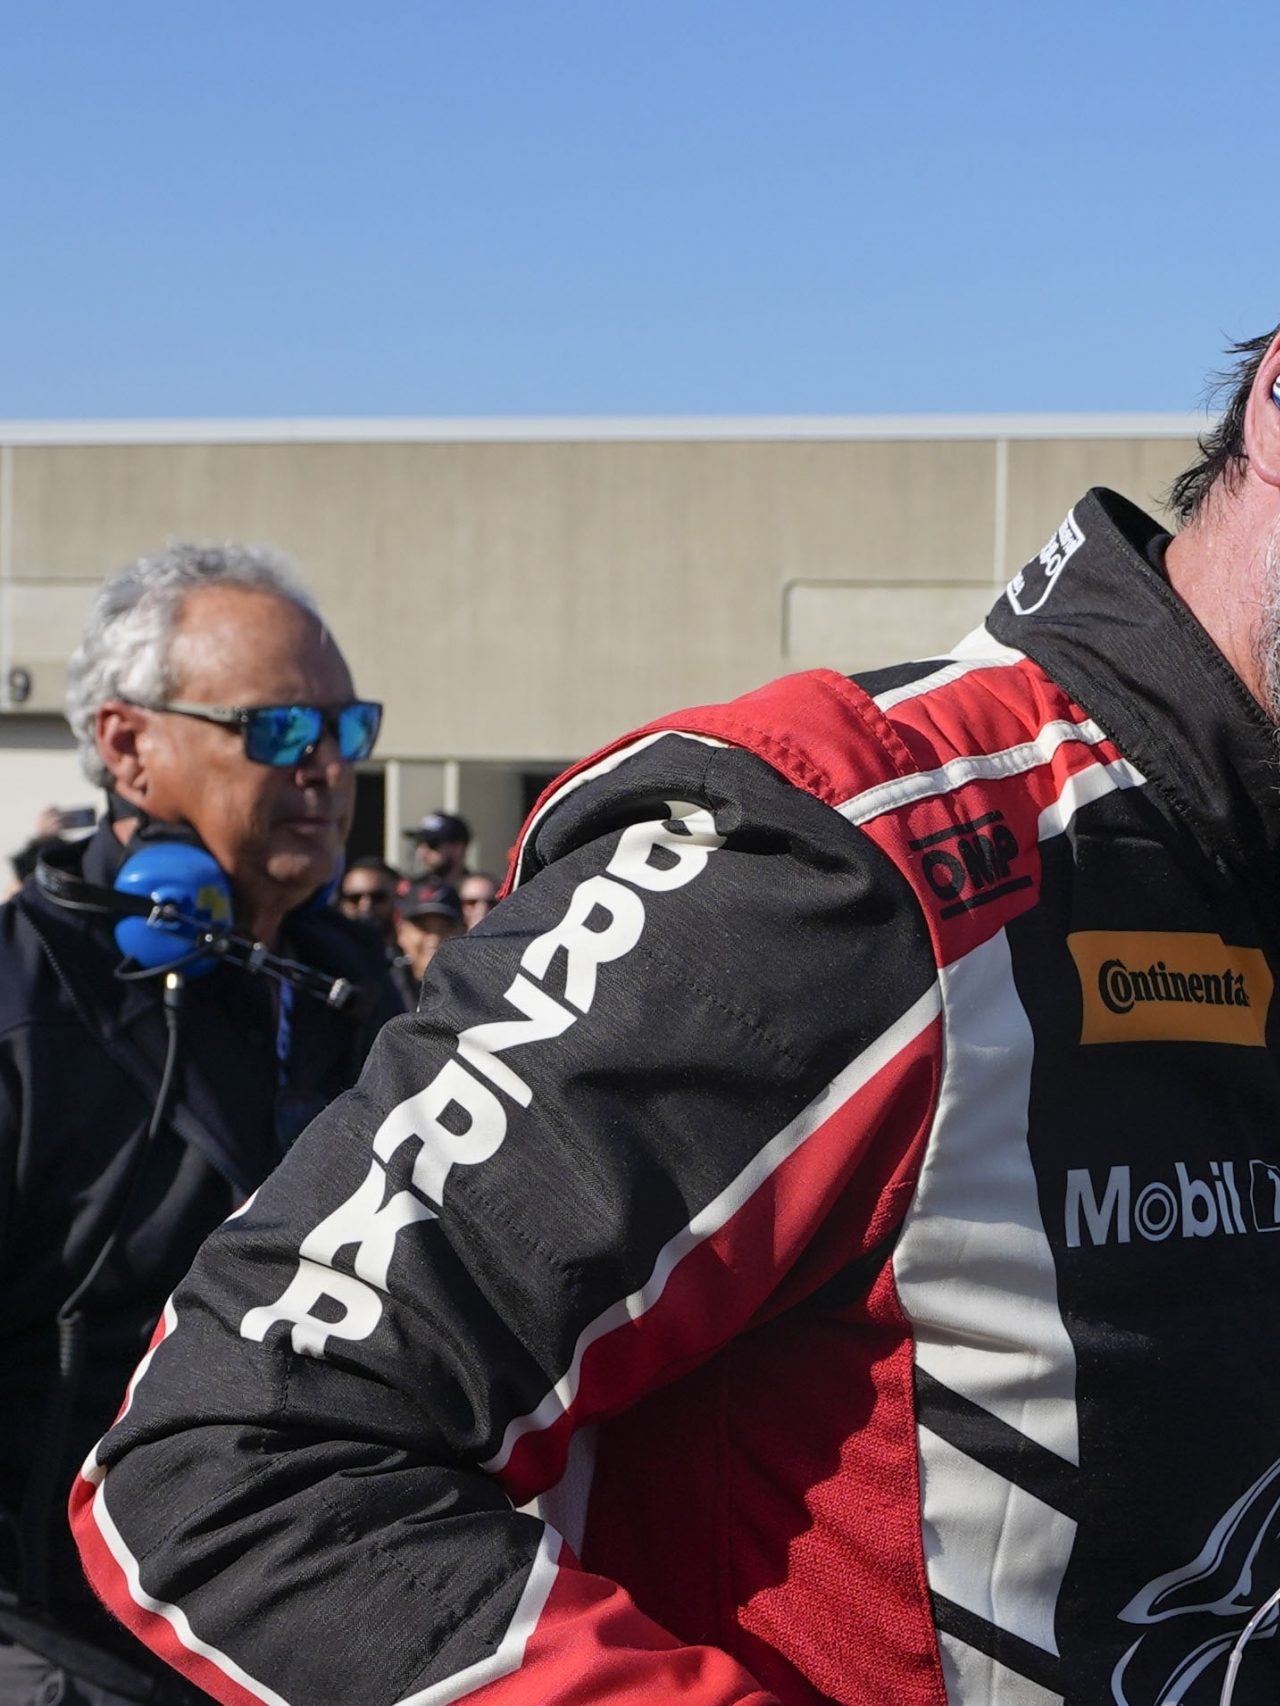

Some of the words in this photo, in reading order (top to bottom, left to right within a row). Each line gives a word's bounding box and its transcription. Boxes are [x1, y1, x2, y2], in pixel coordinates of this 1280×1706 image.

[922, 825, 1019, 900] OMP
[1098, 959, 1251, 1014] Continenta
[240, 800, 727, 1358] BRZRKR
[1064, 1161, 1248, 1248] Mobil
